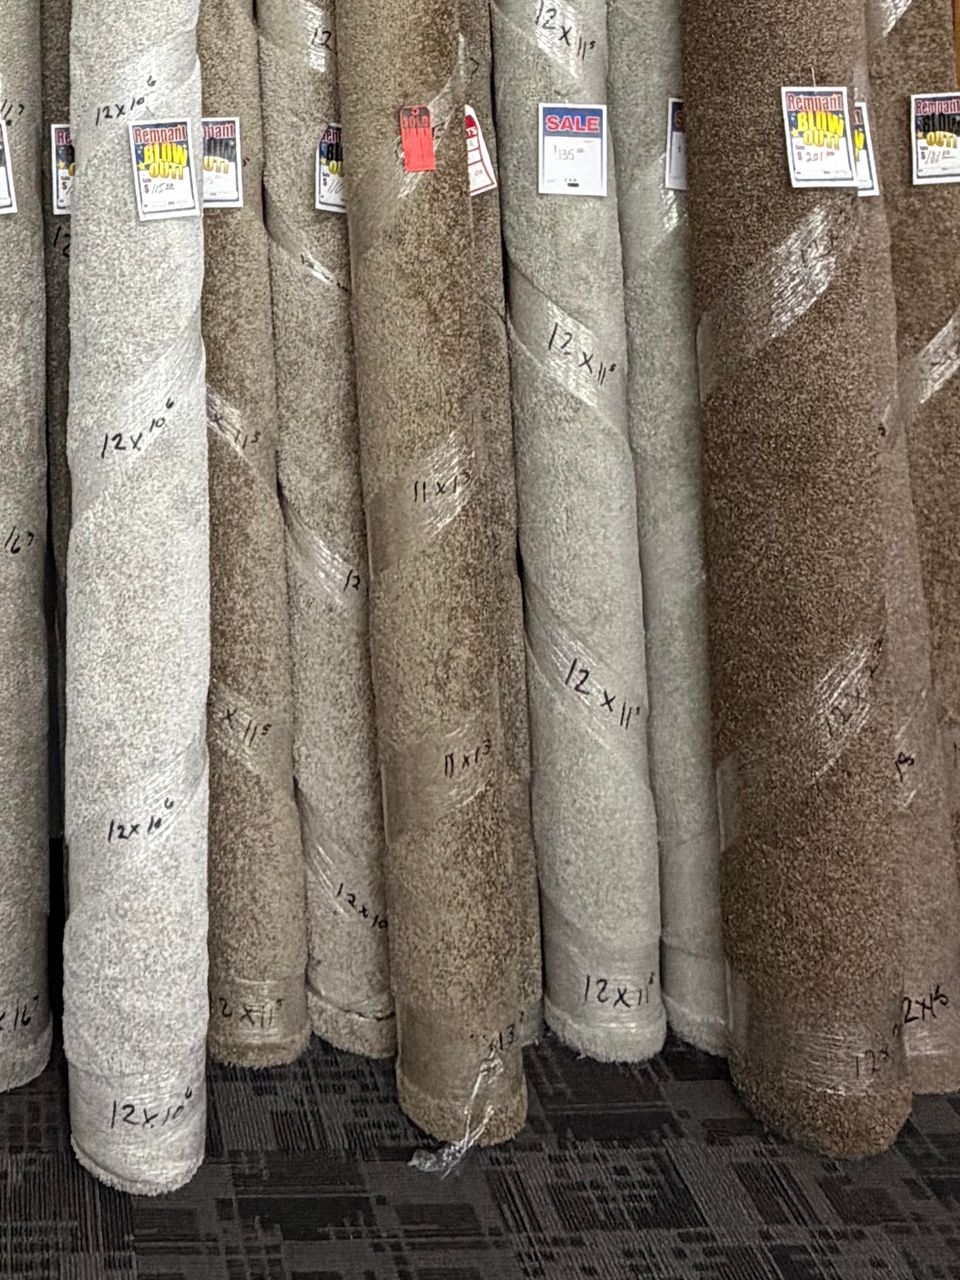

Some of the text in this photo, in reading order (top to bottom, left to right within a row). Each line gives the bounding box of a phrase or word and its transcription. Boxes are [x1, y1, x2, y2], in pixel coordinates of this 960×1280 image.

[787, 94, 843, 111] Remnant
[546, 115, 600, 133] SALE
[797, 111, 844, 137] BLOW
[134, 126, 187, 143] Remnant
[144, 143, 187, 166] BLOW
